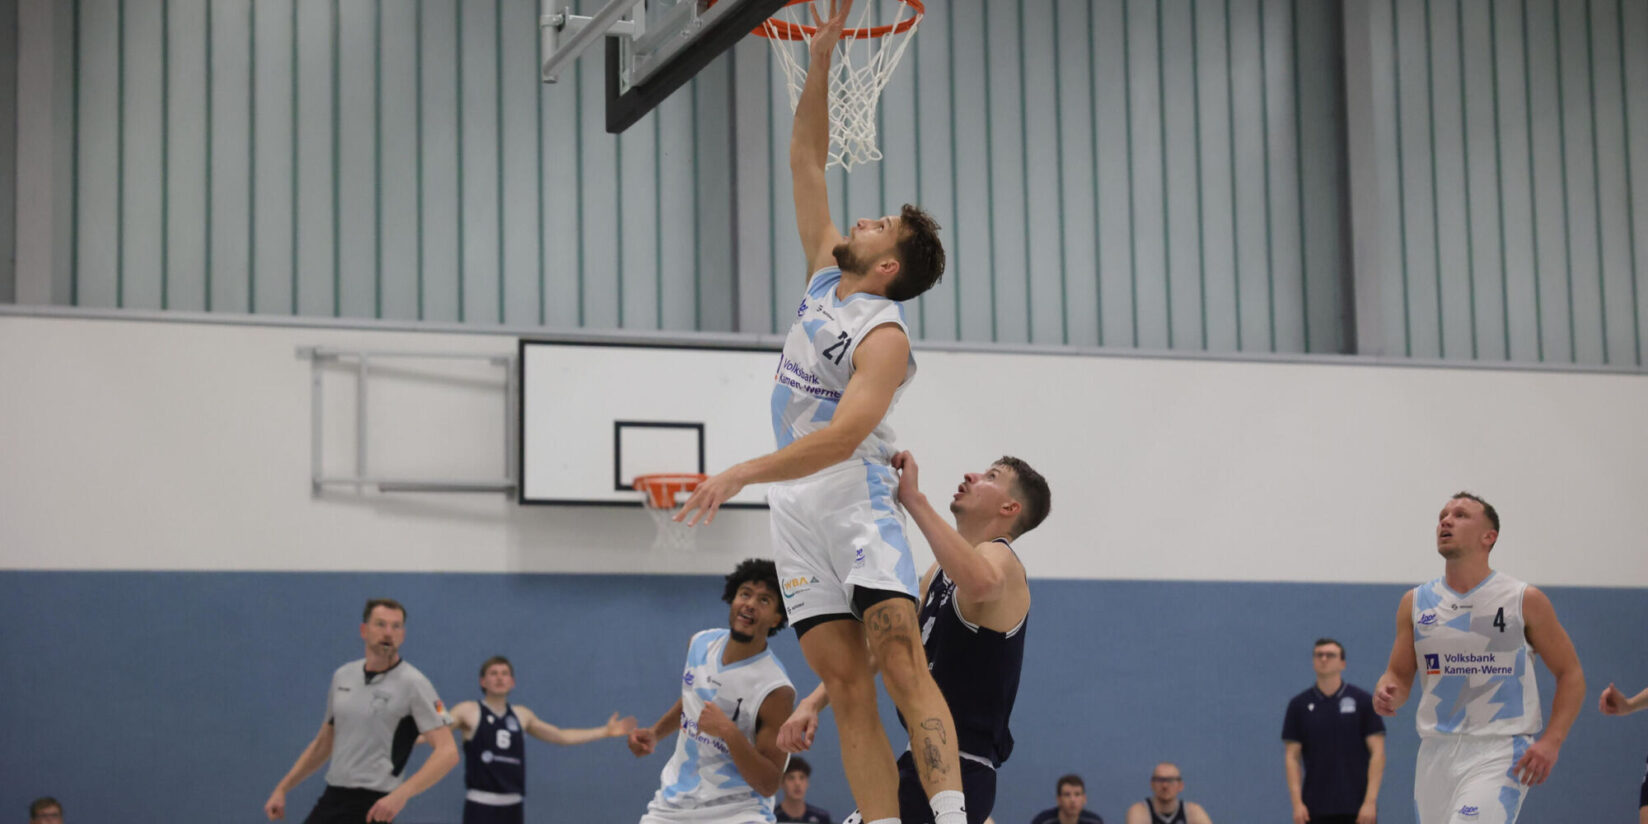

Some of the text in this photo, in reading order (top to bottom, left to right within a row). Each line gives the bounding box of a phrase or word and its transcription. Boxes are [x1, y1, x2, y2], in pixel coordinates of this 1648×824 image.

[822, 330, 852, 365] 21
[784, 576, 808, 590] WBA
[1492, 607, 1506, 632] 4
[1444, 653, 1496, 663] Volksbank
[1444, 665, 1513, 675] Kamen-Werne
[496, 729, 511, 749] 6
